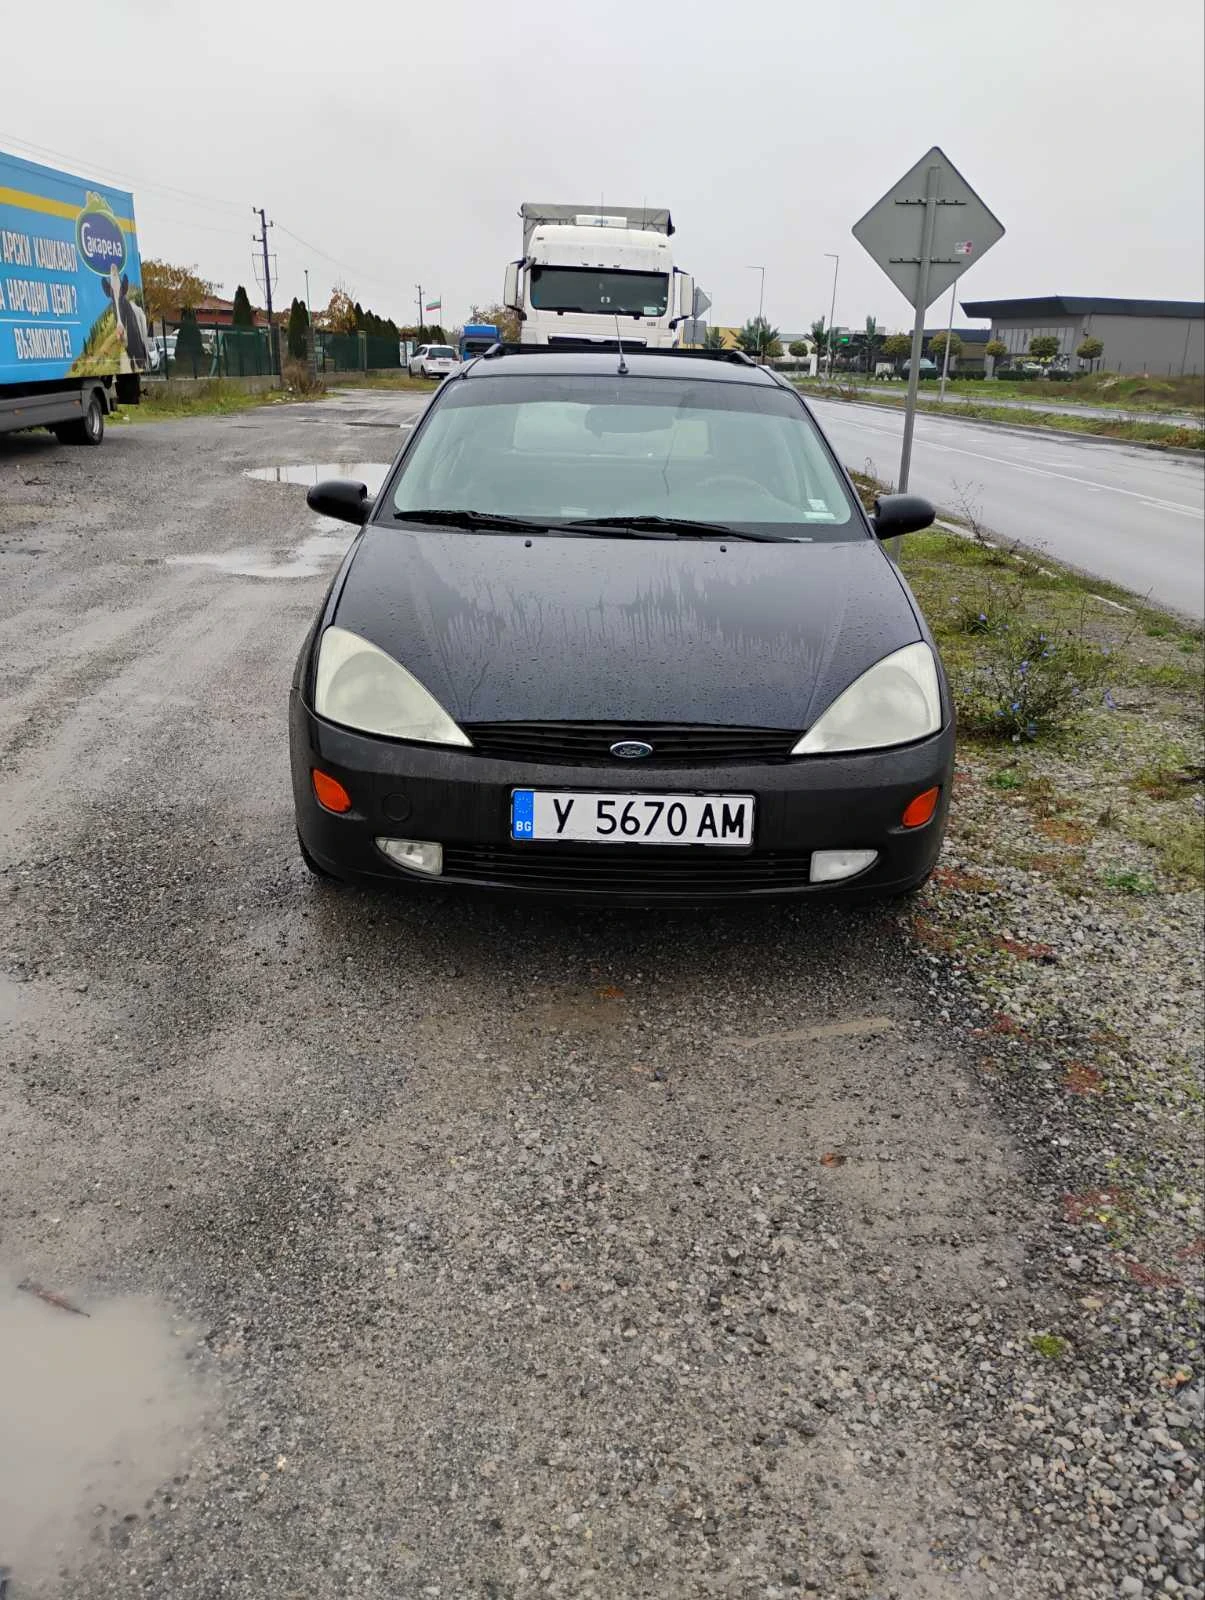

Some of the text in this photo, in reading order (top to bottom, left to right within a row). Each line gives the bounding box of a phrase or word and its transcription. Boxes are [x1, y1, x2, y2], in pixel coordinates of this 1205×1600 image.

[0, 230, 78, 273] АРСКИ КАШКАВАЛ
[81, 222, 122, 260] Сакарела
[6, 278, 50, 316] НАРОДНИ
[14, 327, 64, 359] ВЪЗМОЖНО
[516, 821, 532, 832] BG
[596, 800, 688, 837] 5670
